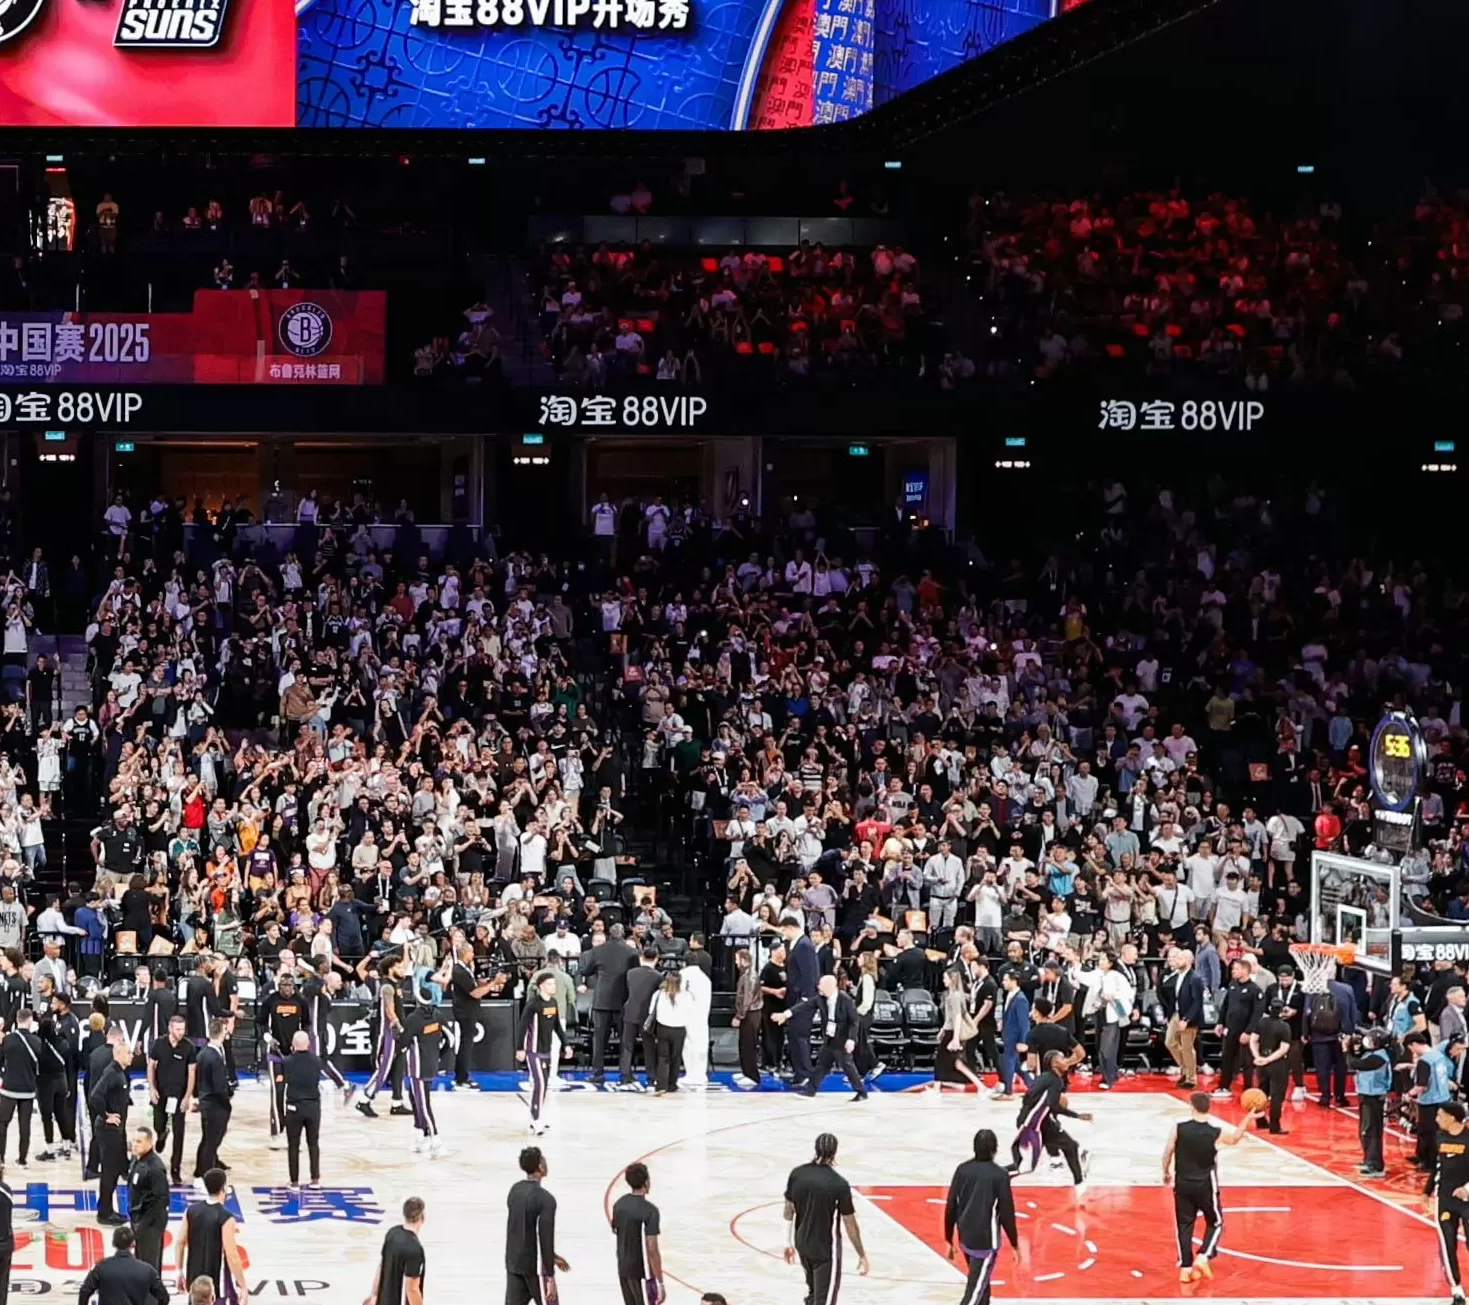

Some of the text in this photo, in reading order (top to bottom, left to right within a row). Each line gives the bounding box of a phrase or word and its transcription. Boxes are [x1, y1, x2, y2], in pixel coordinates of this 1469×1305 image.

[120, 8, 218, 41] SUNS
[89, 323, 150, 363] 2025
[1385, 733, 1411, 758] 5:36
